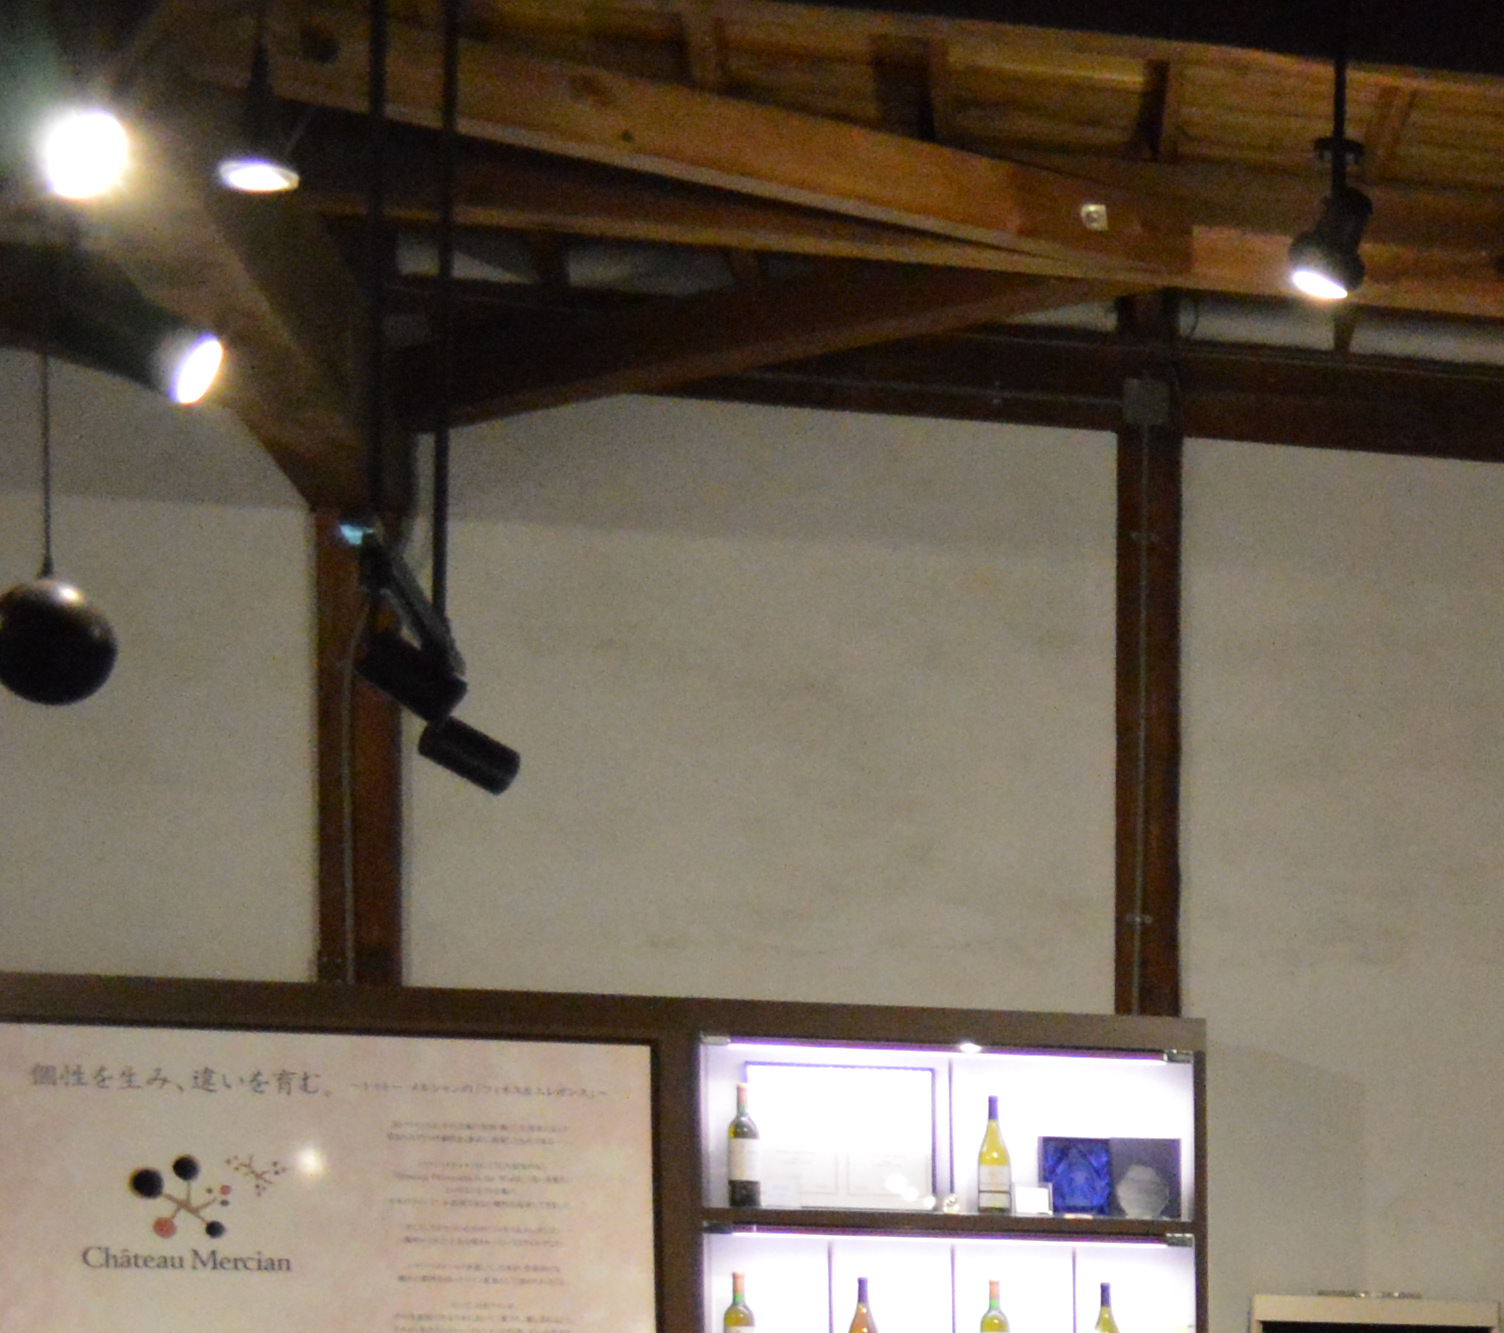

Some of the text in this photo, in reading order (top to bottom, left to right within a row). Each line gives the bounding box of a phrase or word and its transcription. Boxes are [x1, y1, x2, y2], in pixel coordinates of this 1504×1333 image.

[30, 1062, 333, 1098] 個性を生み、違いを育む。
[81, 1246, 292, 1273] Château Mercian
